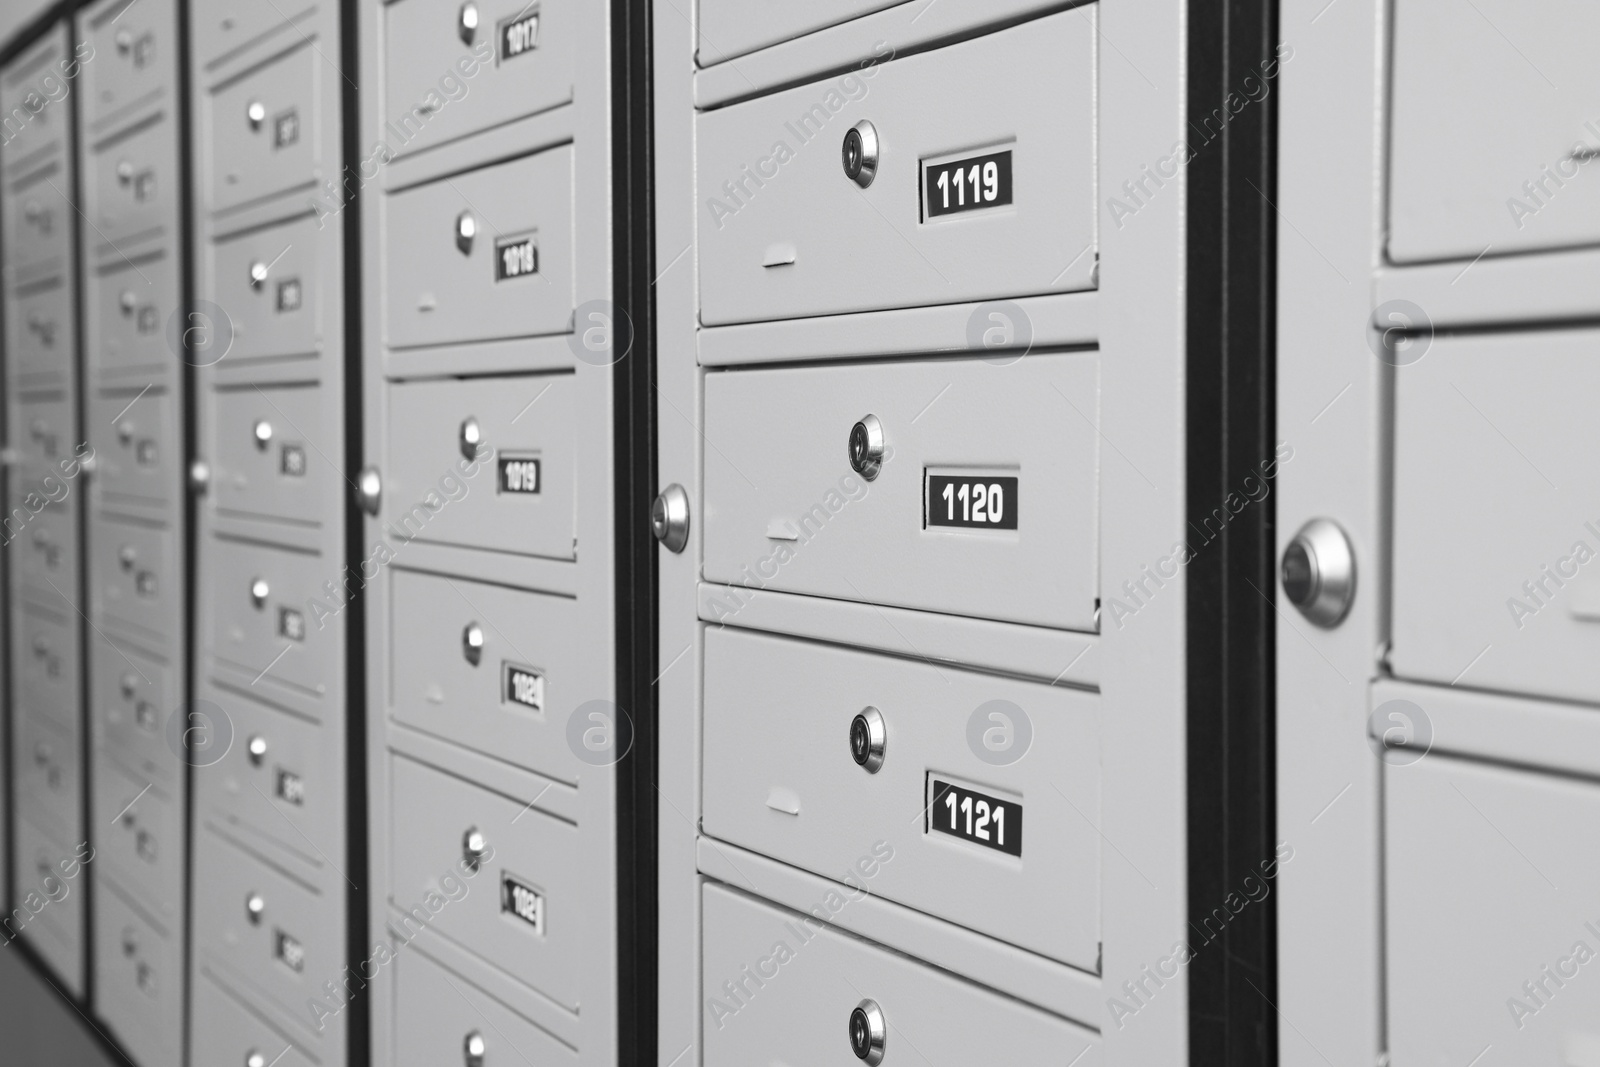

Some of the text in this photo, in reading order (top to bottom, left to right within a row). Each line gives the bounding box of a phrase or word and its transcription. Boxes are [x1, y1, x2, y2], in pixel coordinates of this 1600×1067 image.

[507, 16, 538, 55] 1017
[937, 161, 999, 209] 1119
[505, 461, 536, 491] 1019
[942, 483, 1003, 523] 1120
[945, 791, 1005, 845] 1121
